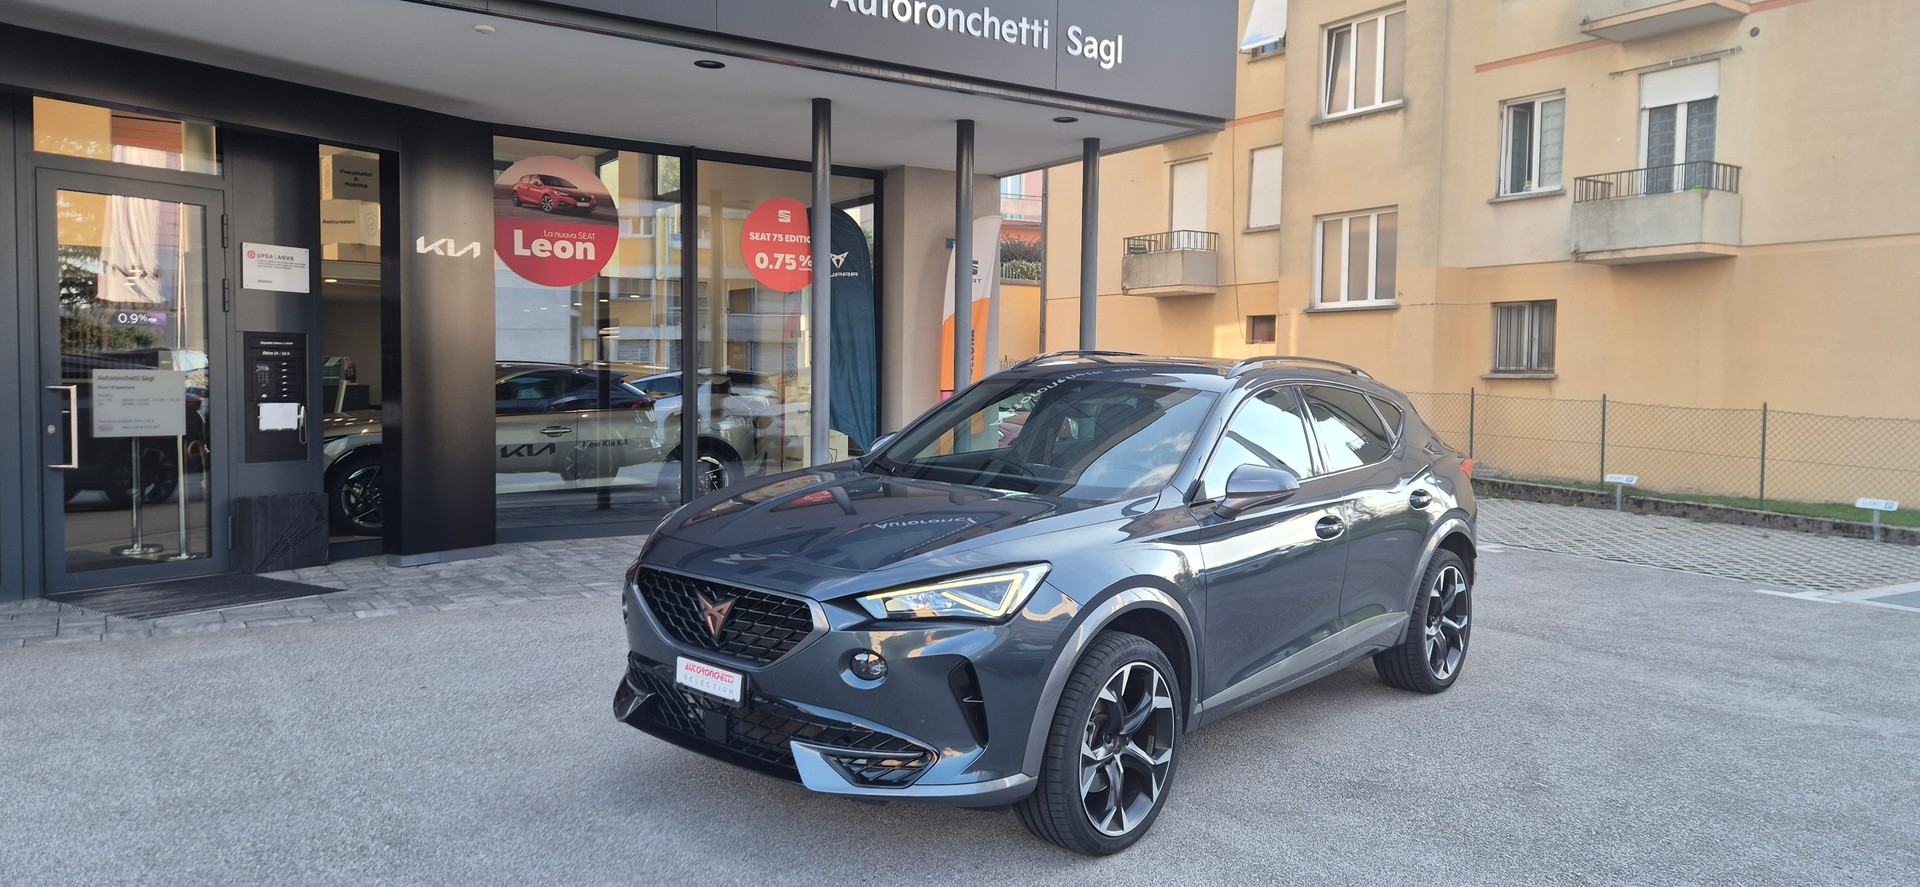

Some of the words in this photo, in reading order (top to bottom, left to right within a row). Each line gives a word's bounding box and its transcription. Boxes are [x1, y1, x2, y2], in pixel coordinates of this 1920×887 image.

[1066, 25, 1124, 69] Sagl
[544, 229, 553, 238] La
[554, 231, 576, 239] nuova
[577, 231, 596, 240] SEAT
[749, 231, 771, 241] SEAT
[772, 233, 784, 242] 75
[513, 229, 596, 261] Leon
[118, 312, 148, 324] 0.9%
[602, 439, 616, 447] Kia
[683, 674, 735, 695] SELECTION
